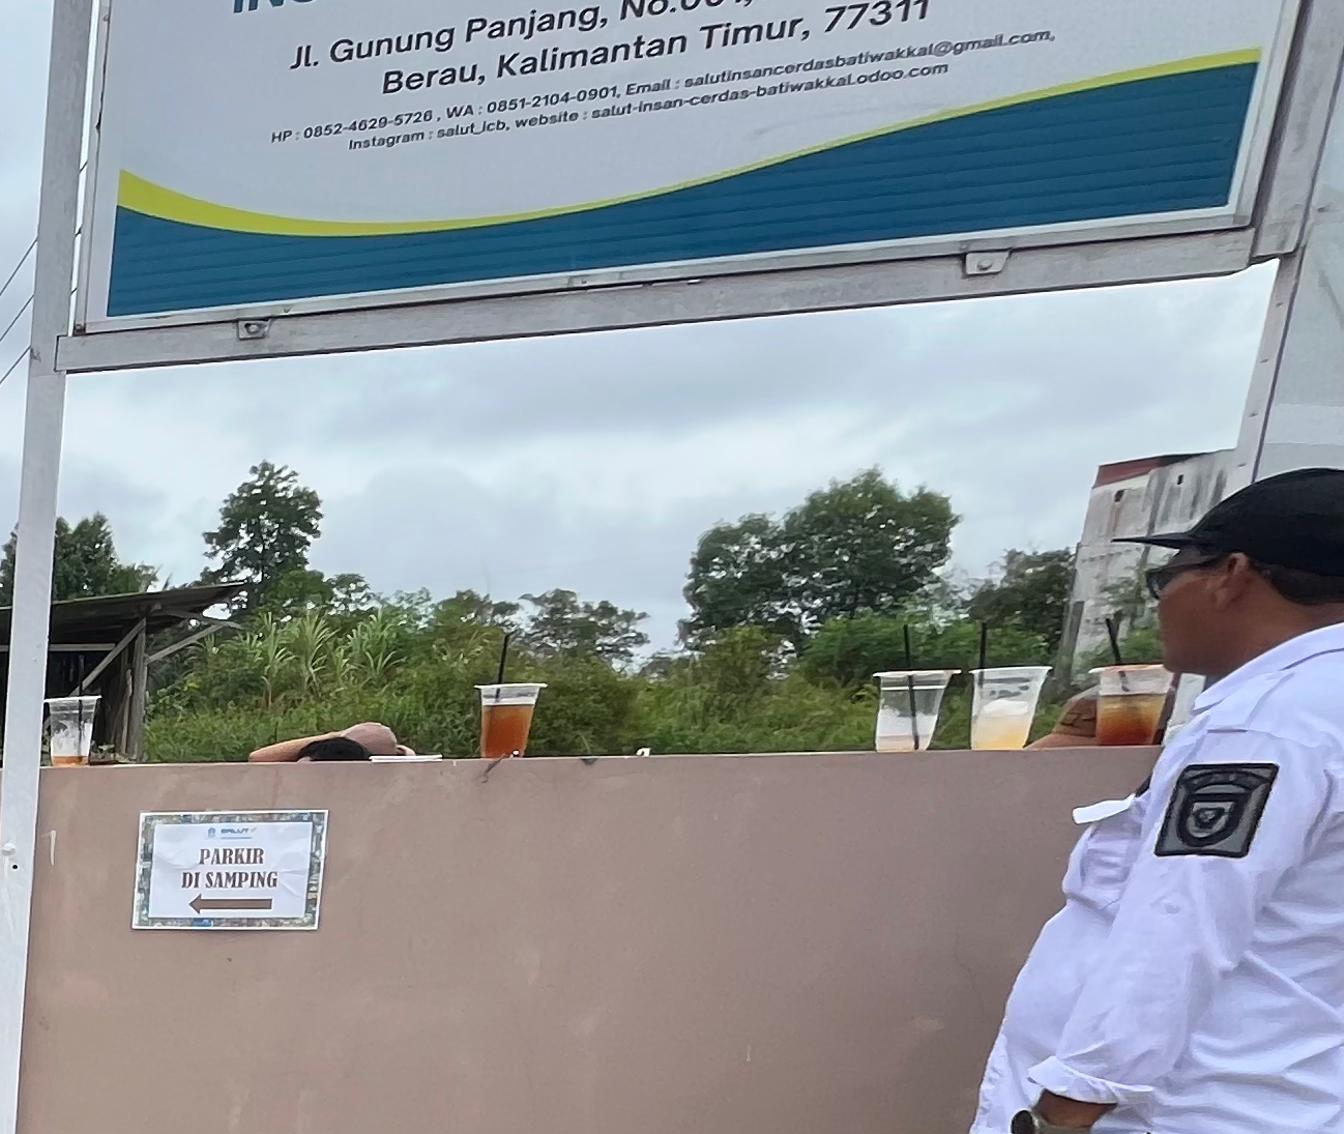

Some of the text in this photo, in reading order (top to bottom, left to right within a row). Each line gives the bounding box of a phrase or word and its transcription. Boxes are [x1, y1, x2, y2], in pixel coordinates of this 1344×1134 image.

[290, 46, 319, 70] Jl.
[329, 27, 455, 63] Gunung
[465, 5, 608, 42] Panjang,
[382, 0, 929, 95] Berau, Kalimantan Timur, 77311
[271, 129, 293, 144] HP
[446, 104, 474, 119] WA
[625, 79, 671, 96] Email
[348, 130, 425, 151] Instagram
[515, 111, 579, 129] website
[181, 872, 279, 888] DI SAMPING
[198, 848, 265, 865] PARKIR
